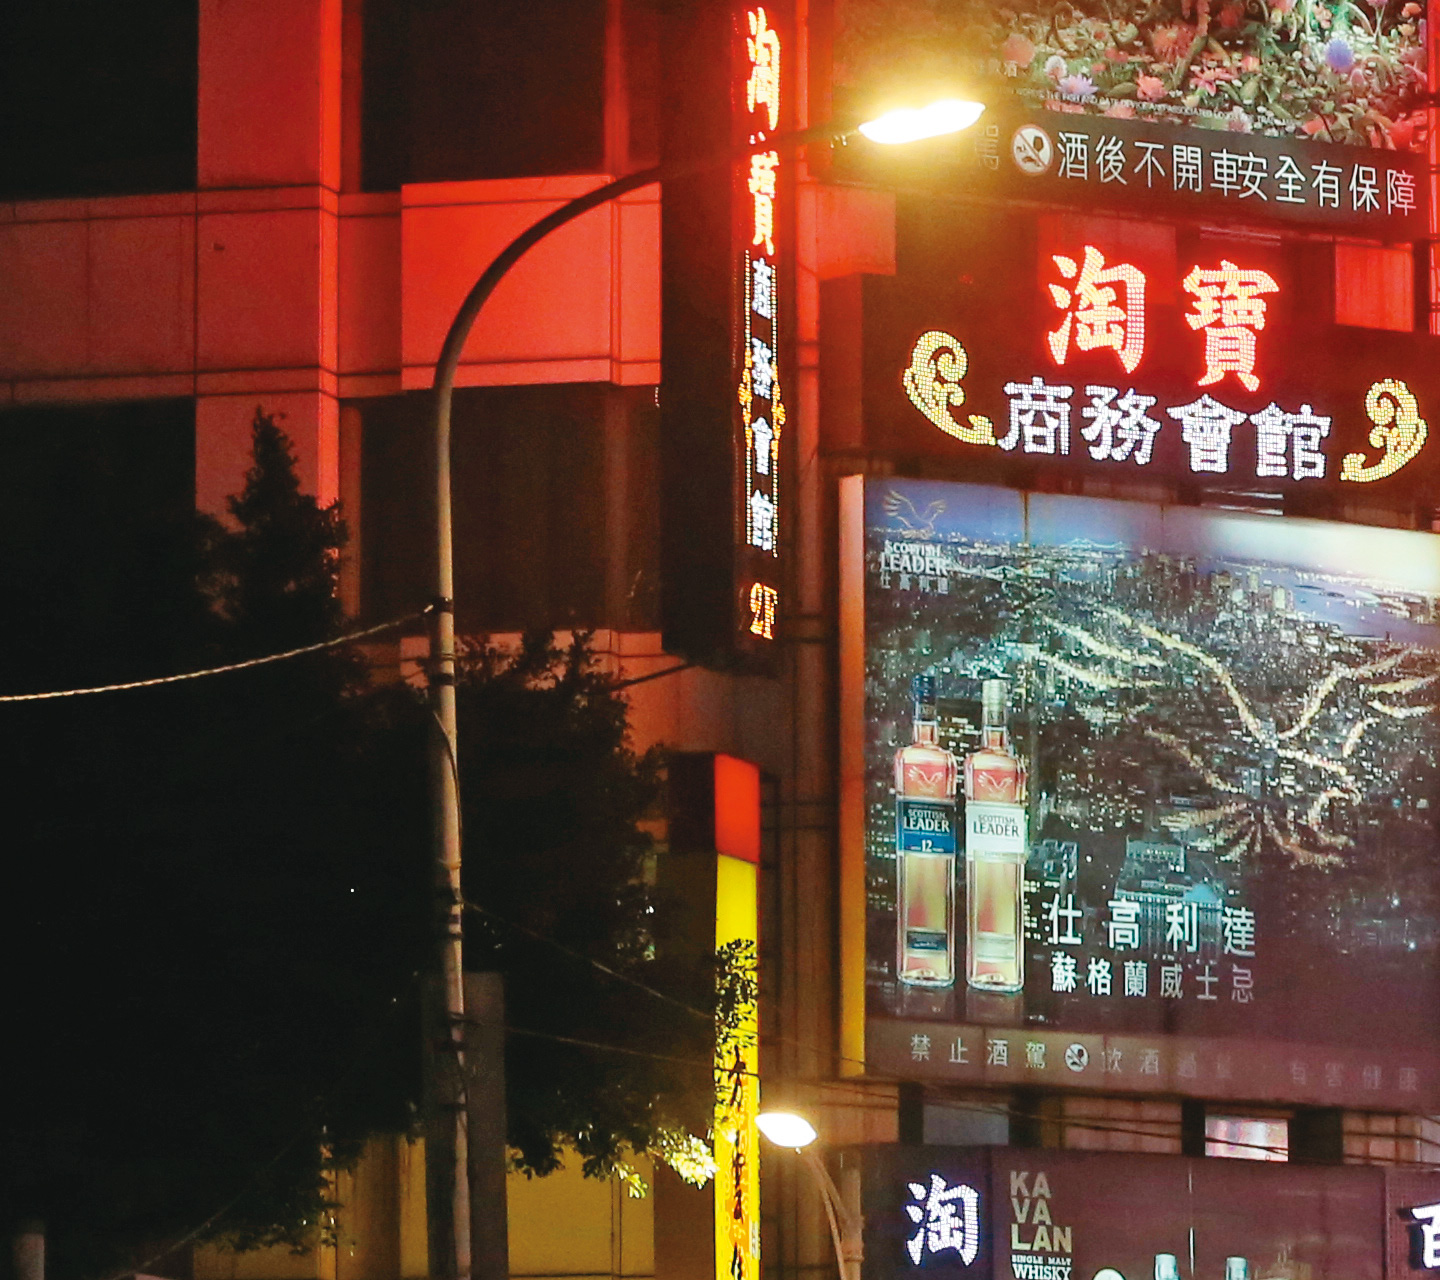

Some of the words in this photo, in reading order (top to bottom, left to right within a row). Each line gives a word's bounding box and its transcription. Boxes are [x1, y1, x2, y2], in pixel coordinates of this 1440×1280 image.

[1056, 130, 1417, 217] 酒後不開車安全有保障
[1047, 245, 1280, 392] 淘寶
[998, 376, 1332, 482] 商務會館
[880, 552, 948, 576] LEADER
[903, 816, 950, 833] LEADER
[973, 821, 1019, 837] LEADER
[921, 839, 933, 852] 12
[1048, 897, 1257, 958] 仕高利達
[1050, 957, 1256, 1006] 蘇格蘭威士忌
[909, 1032, 1048, 1070] 禁止酒駕
[1010, 1170, 1052, 1198] KA
[1011, 1198, 1052, 1225] VA
[1011, 1223, 1072, 1253] LAN
[1012, 1254, 1044, 1265] SINGLE
[1048, 1256, 1072, 1267] MALT
